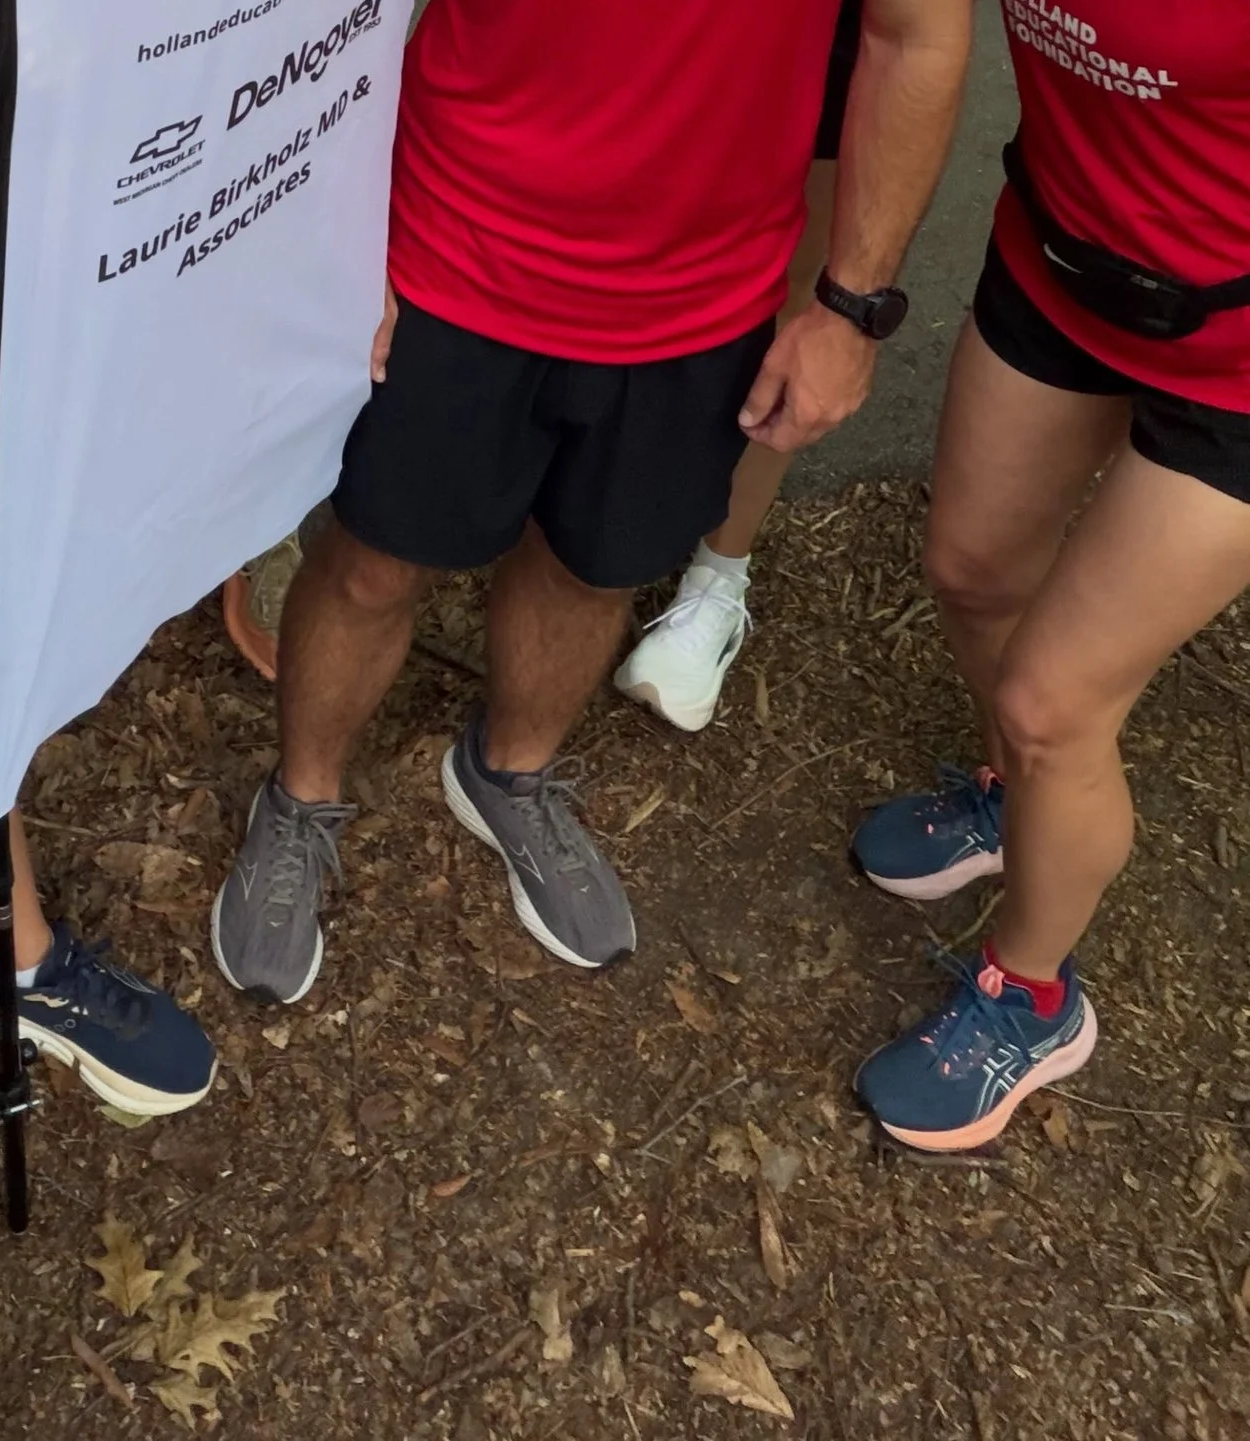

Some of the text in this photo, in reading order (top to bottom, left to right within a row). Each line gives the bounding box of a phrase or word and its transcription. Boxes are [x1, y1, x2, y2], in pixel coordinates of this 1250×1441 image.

[98, 74, 372, 283] Laurie Birkholz MD &
[117, 139, 206, 189] CHEVROLET
[176, 161, 312, 278] Associates
